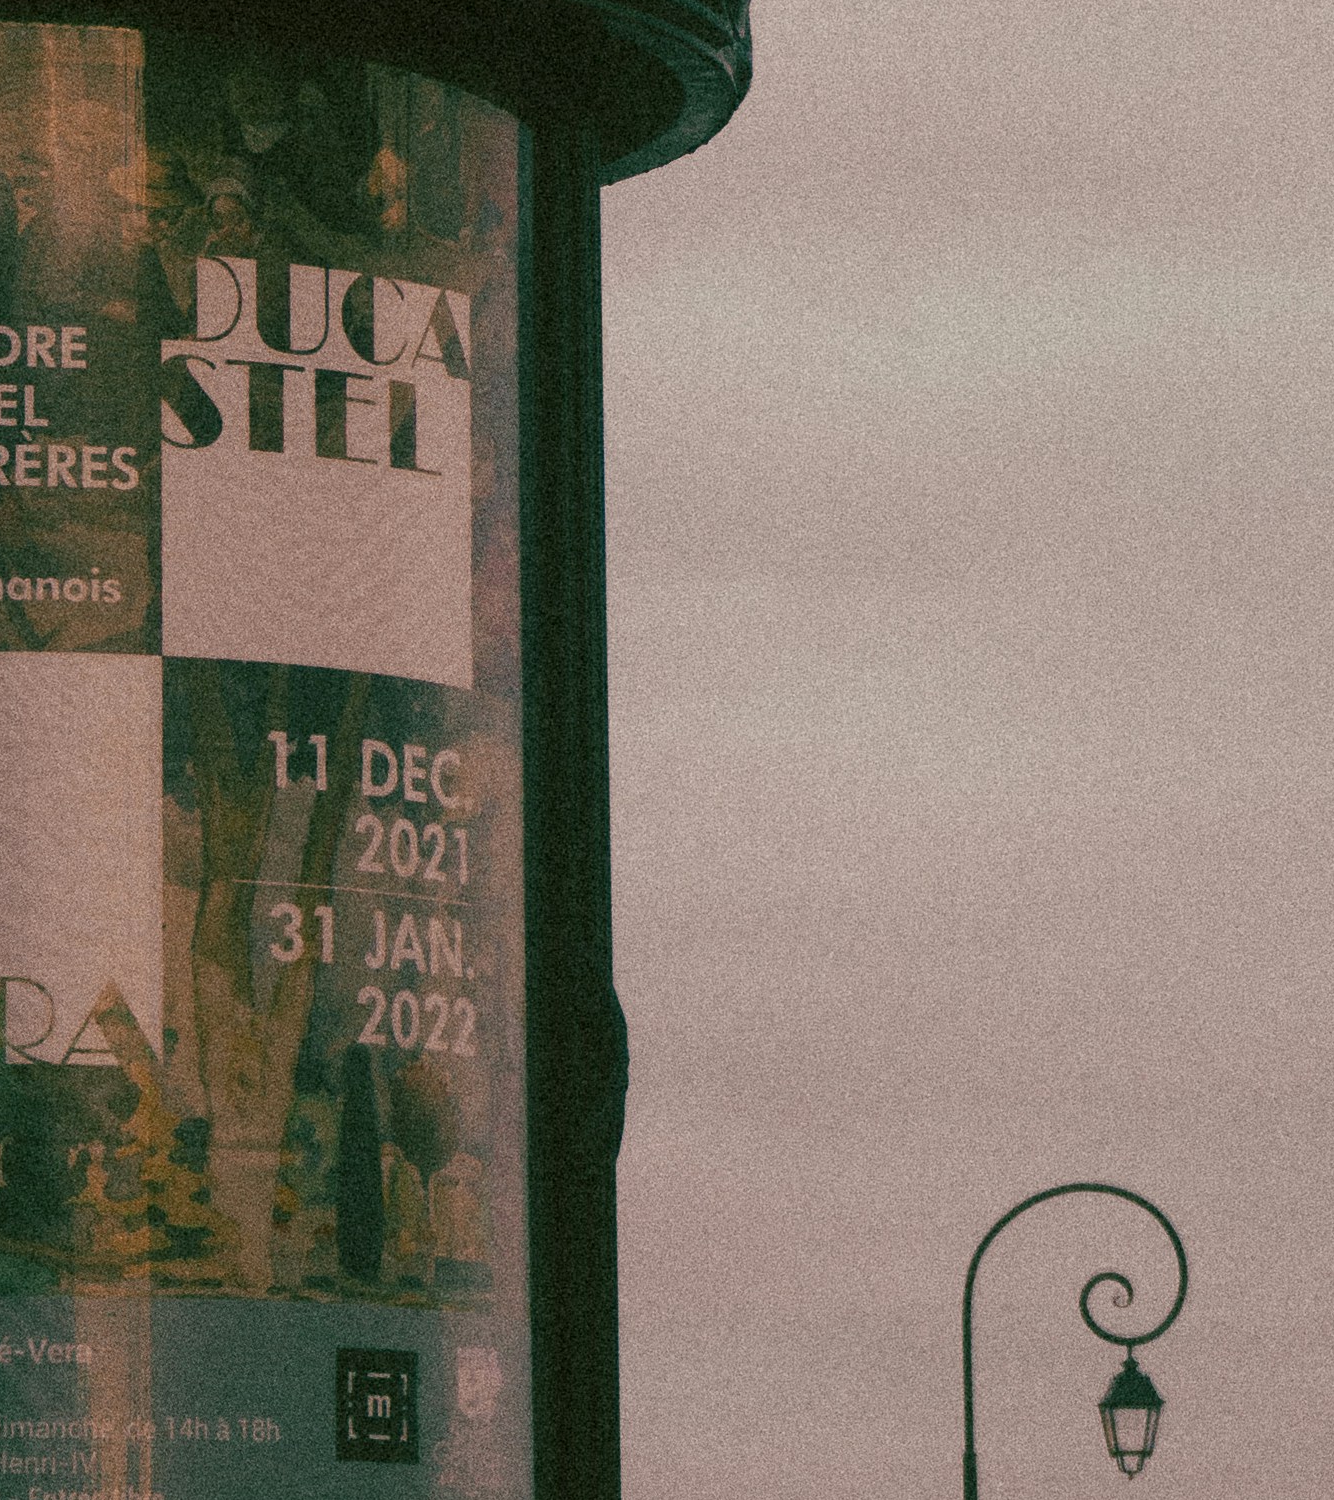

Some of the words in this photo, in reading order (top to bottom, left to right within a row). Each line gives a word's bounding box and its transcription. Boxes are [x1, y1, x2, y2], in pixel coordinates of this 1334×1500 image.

[179, 257, 471, 380] DUCA
[161, 356, 443, 476] STEL
[268, 732, 330, 791] 11
[361, 737, 475, 811] DEC.
[355, 814, 471, 885] 2021
[268, 902, 336, 963] 31
[364, 908, 476, 976] JAN.
[357, 985, 477, 1056] 2022
[166, 1416, 208, 1441] 14h
[216, 1416, 231, 1441] à
[238, 1416, 282, 1443] 18h
